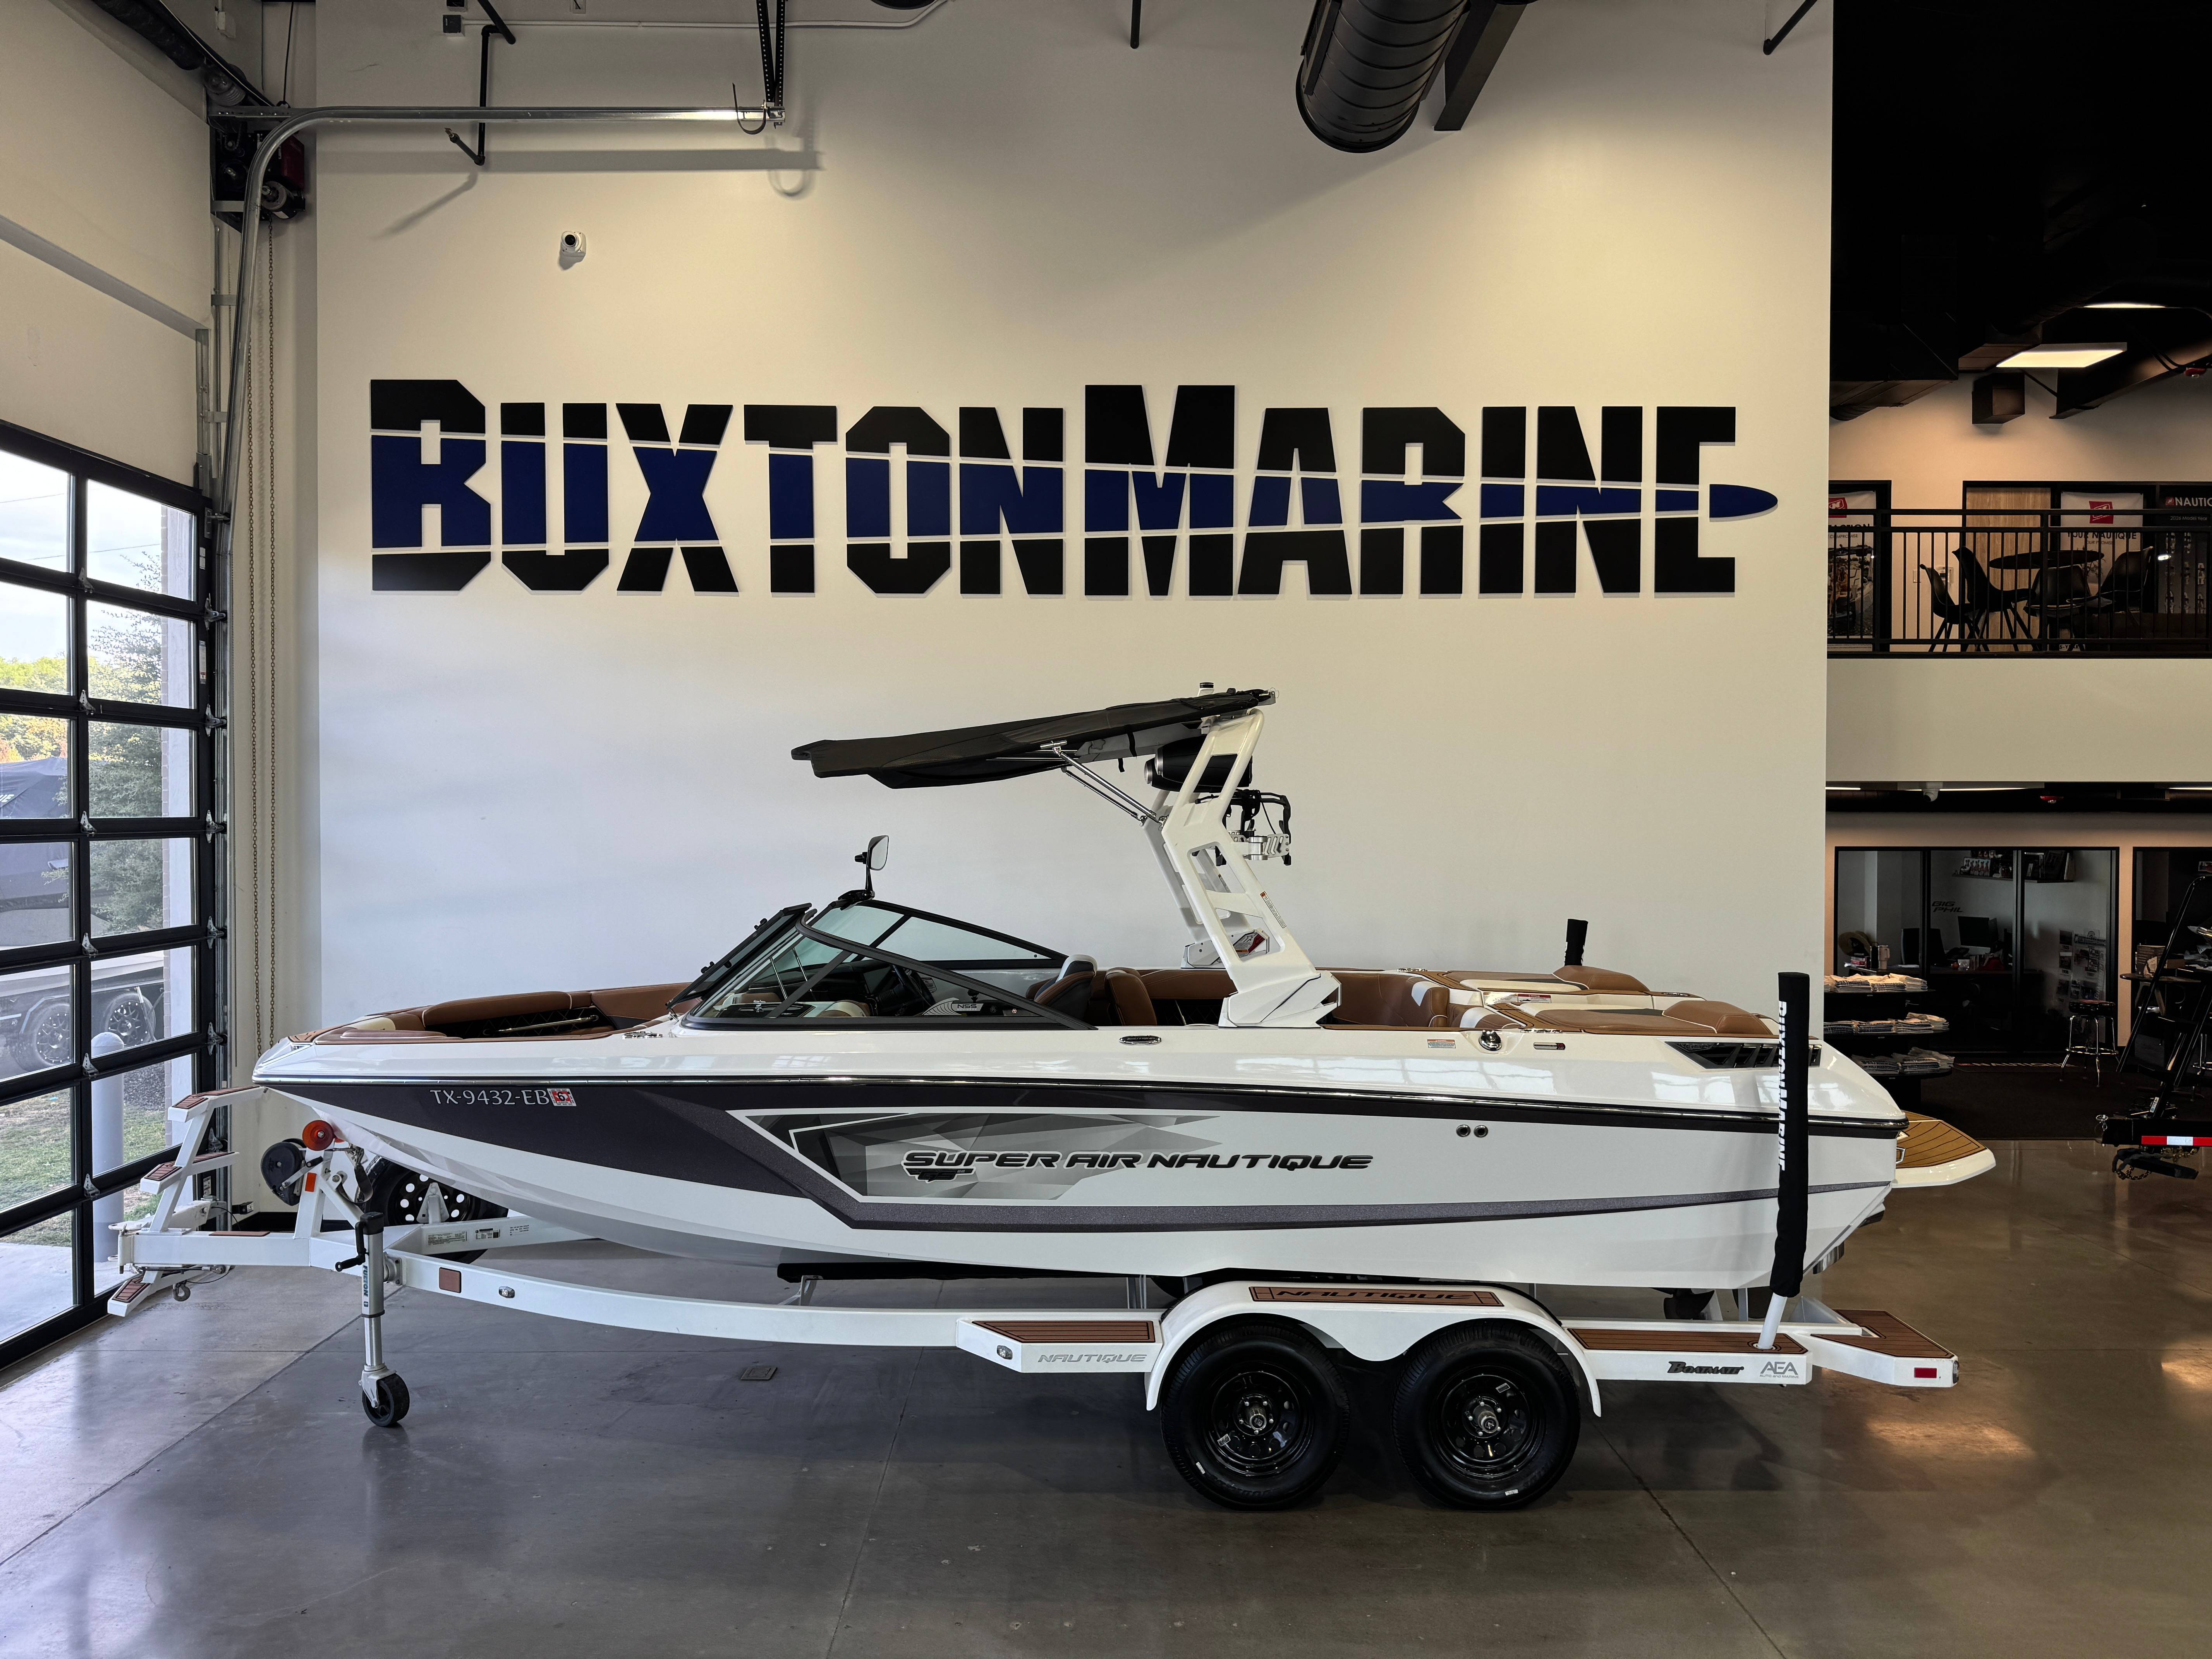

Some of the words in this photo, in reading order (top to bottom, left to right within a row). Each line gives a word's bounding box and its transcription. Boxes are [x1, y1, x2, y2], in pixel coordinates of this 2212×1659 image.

[430, 1089, 550, 1105] TX-9432-EB
[903, 1152, 1061, 1168] SUPER
[1065, 1154, 1142, 1168] AIR
[1146, 1154, 1374, 1171] NAUTIQUE
[1276, 1290, 1473, 1300] NAUTIQUE
[1037, 1354, 1147, 1363] NAUTIQUE
[1760, 1361, 1798, 1375] AEA
